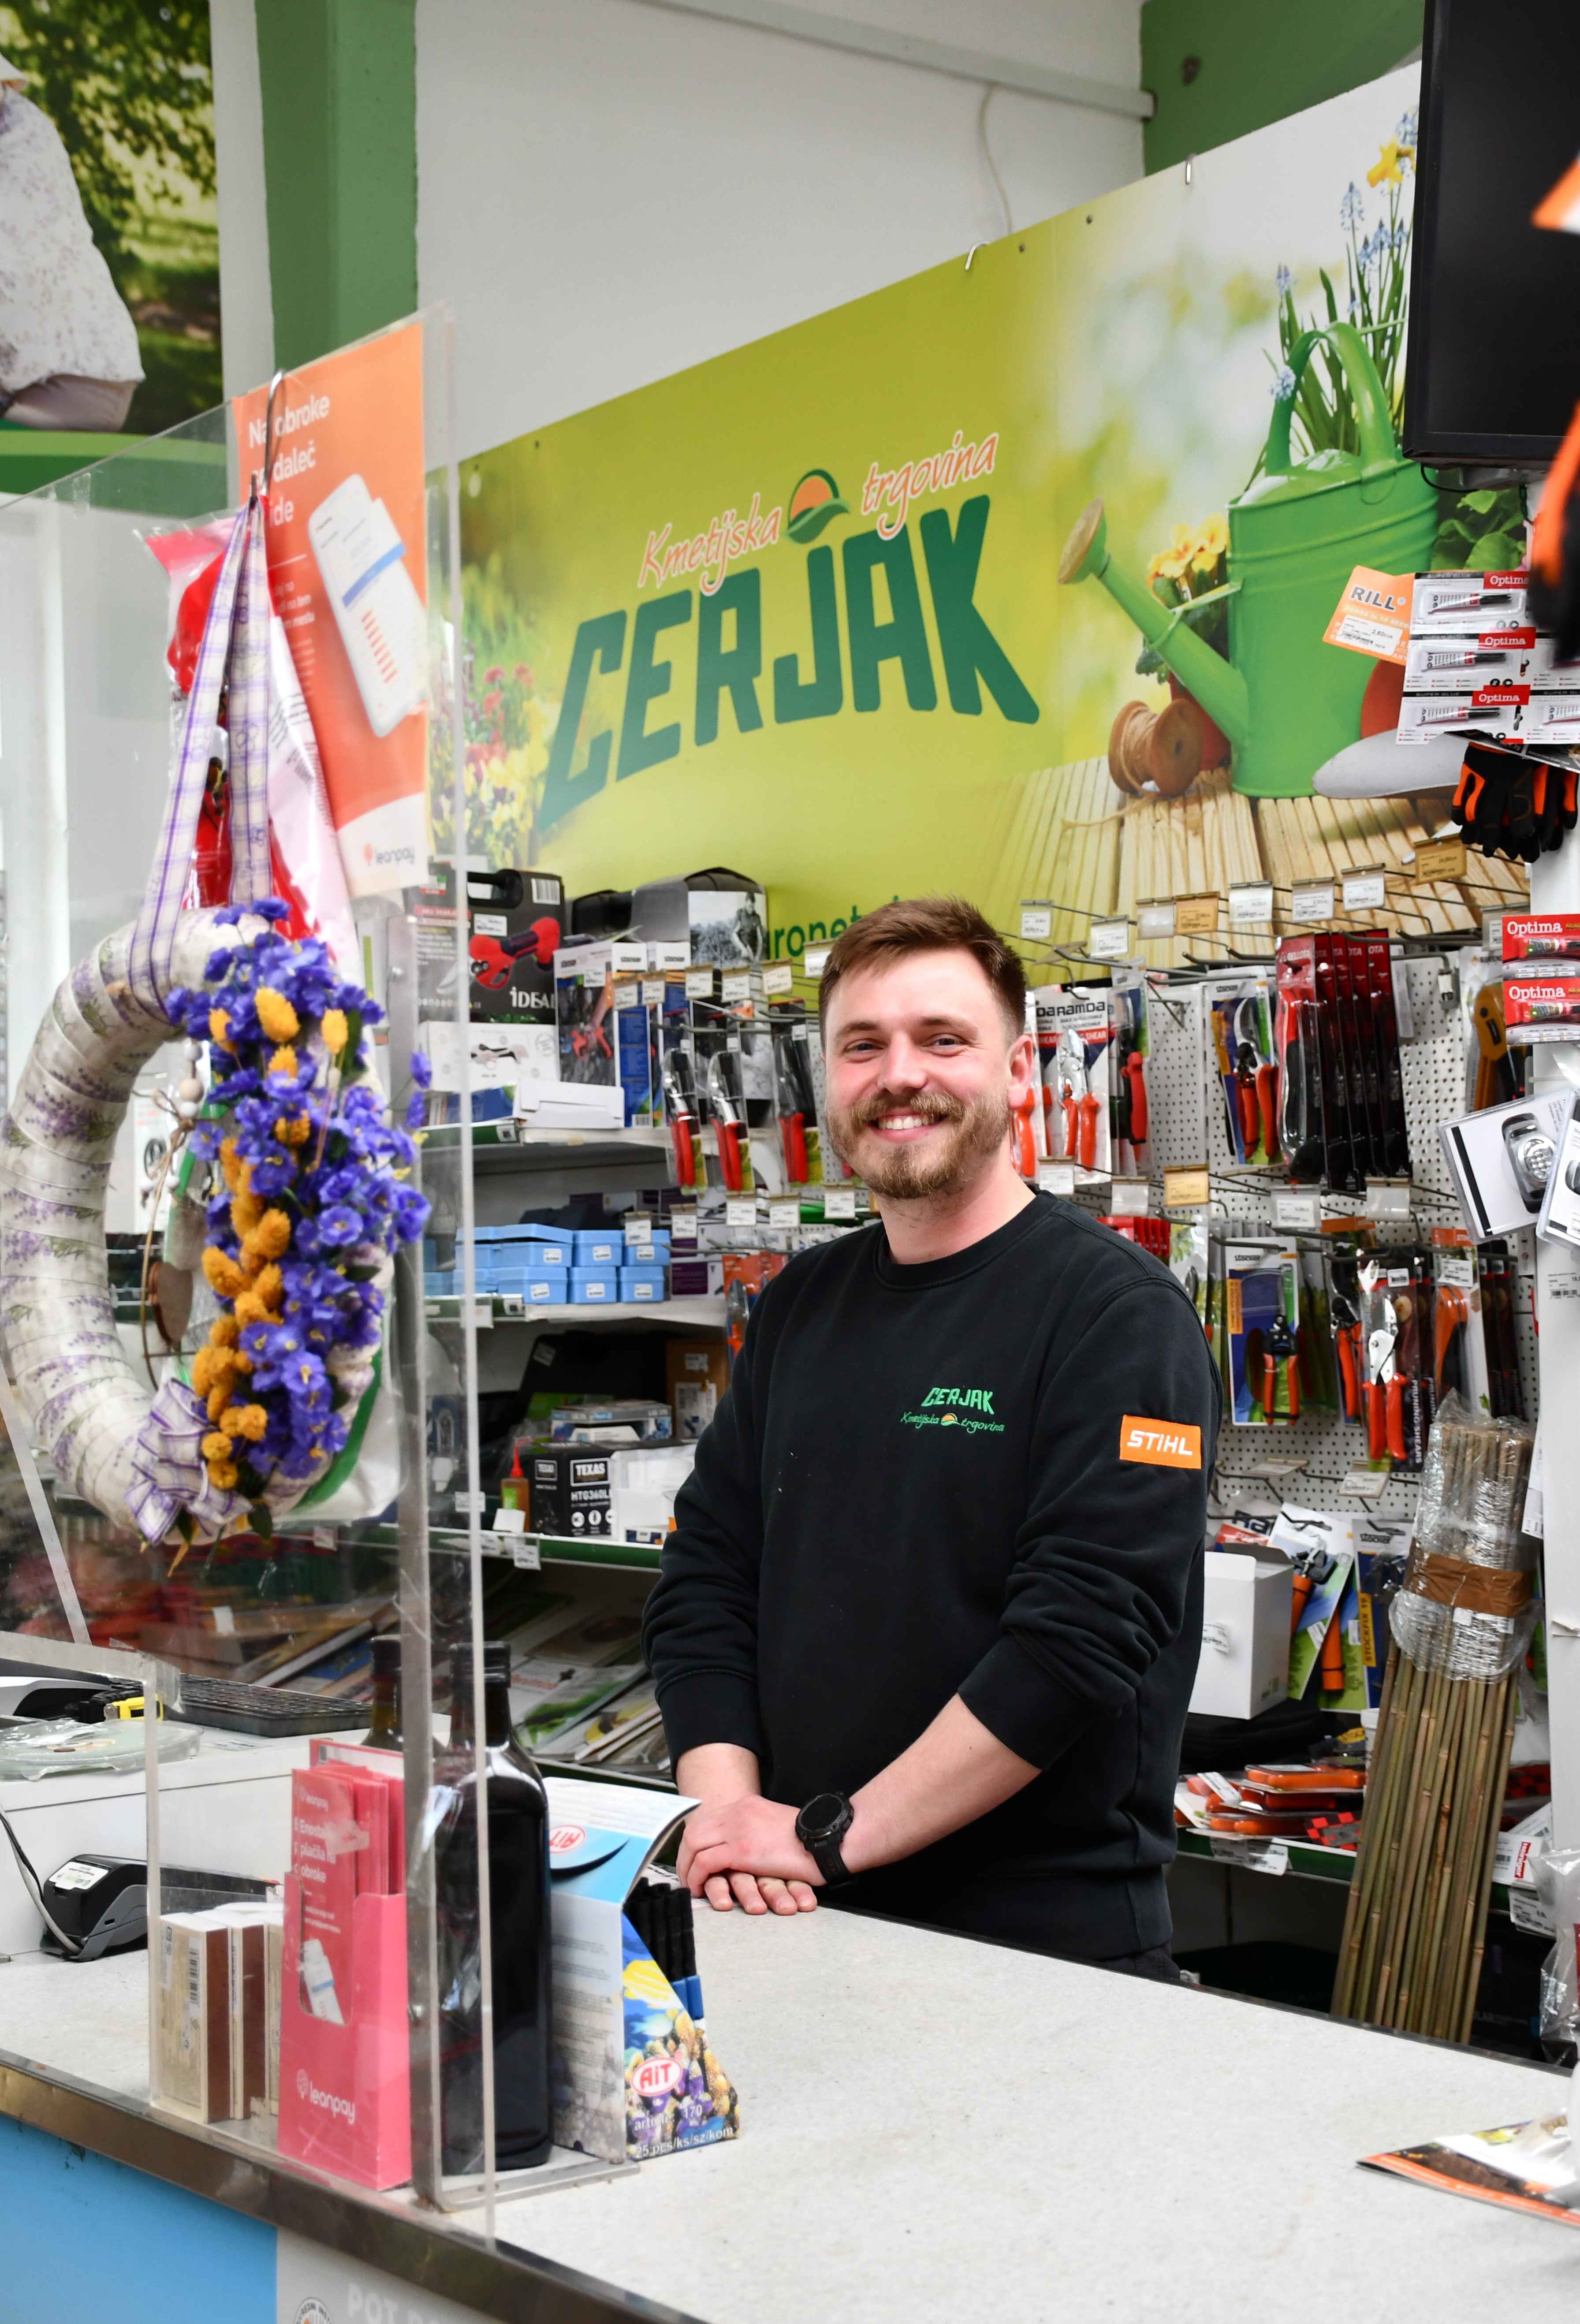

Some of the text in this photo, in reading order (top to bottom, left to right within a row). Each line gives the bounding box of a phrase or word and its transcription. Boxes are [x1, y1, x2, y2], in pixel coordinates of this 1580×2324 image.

[275, 395, 329, 436] obroke
[273, 439, 316, 482] daleč
[638, 430, 998, 596] Kmetijska trgovina
[1350, 586, 1395, 611] RILL
[1485, 637, 1526, 647] Optima
[537, 494, 1040, 831] CERJAK
[1479, 694, 1520, 704] Optima
[1507, 921, 1563, 936] Optima
[1509, 986, 1565, 1000] Optima
[921, 1387, 995, 1415] CERJAK
[961, 1418, 1005, 1434] trgovina
[1412, 1379, 1423, 1464] PRUNING SHEARS
[1127, 1430, 1193, 1456] STIHL
[575, 1463, 606, 1476] TEXAS
[310, 2081, 355, 2125] leanpay
[683, 2104, 703, 2119] 170
[636, 2145, 649, 2159] 25
